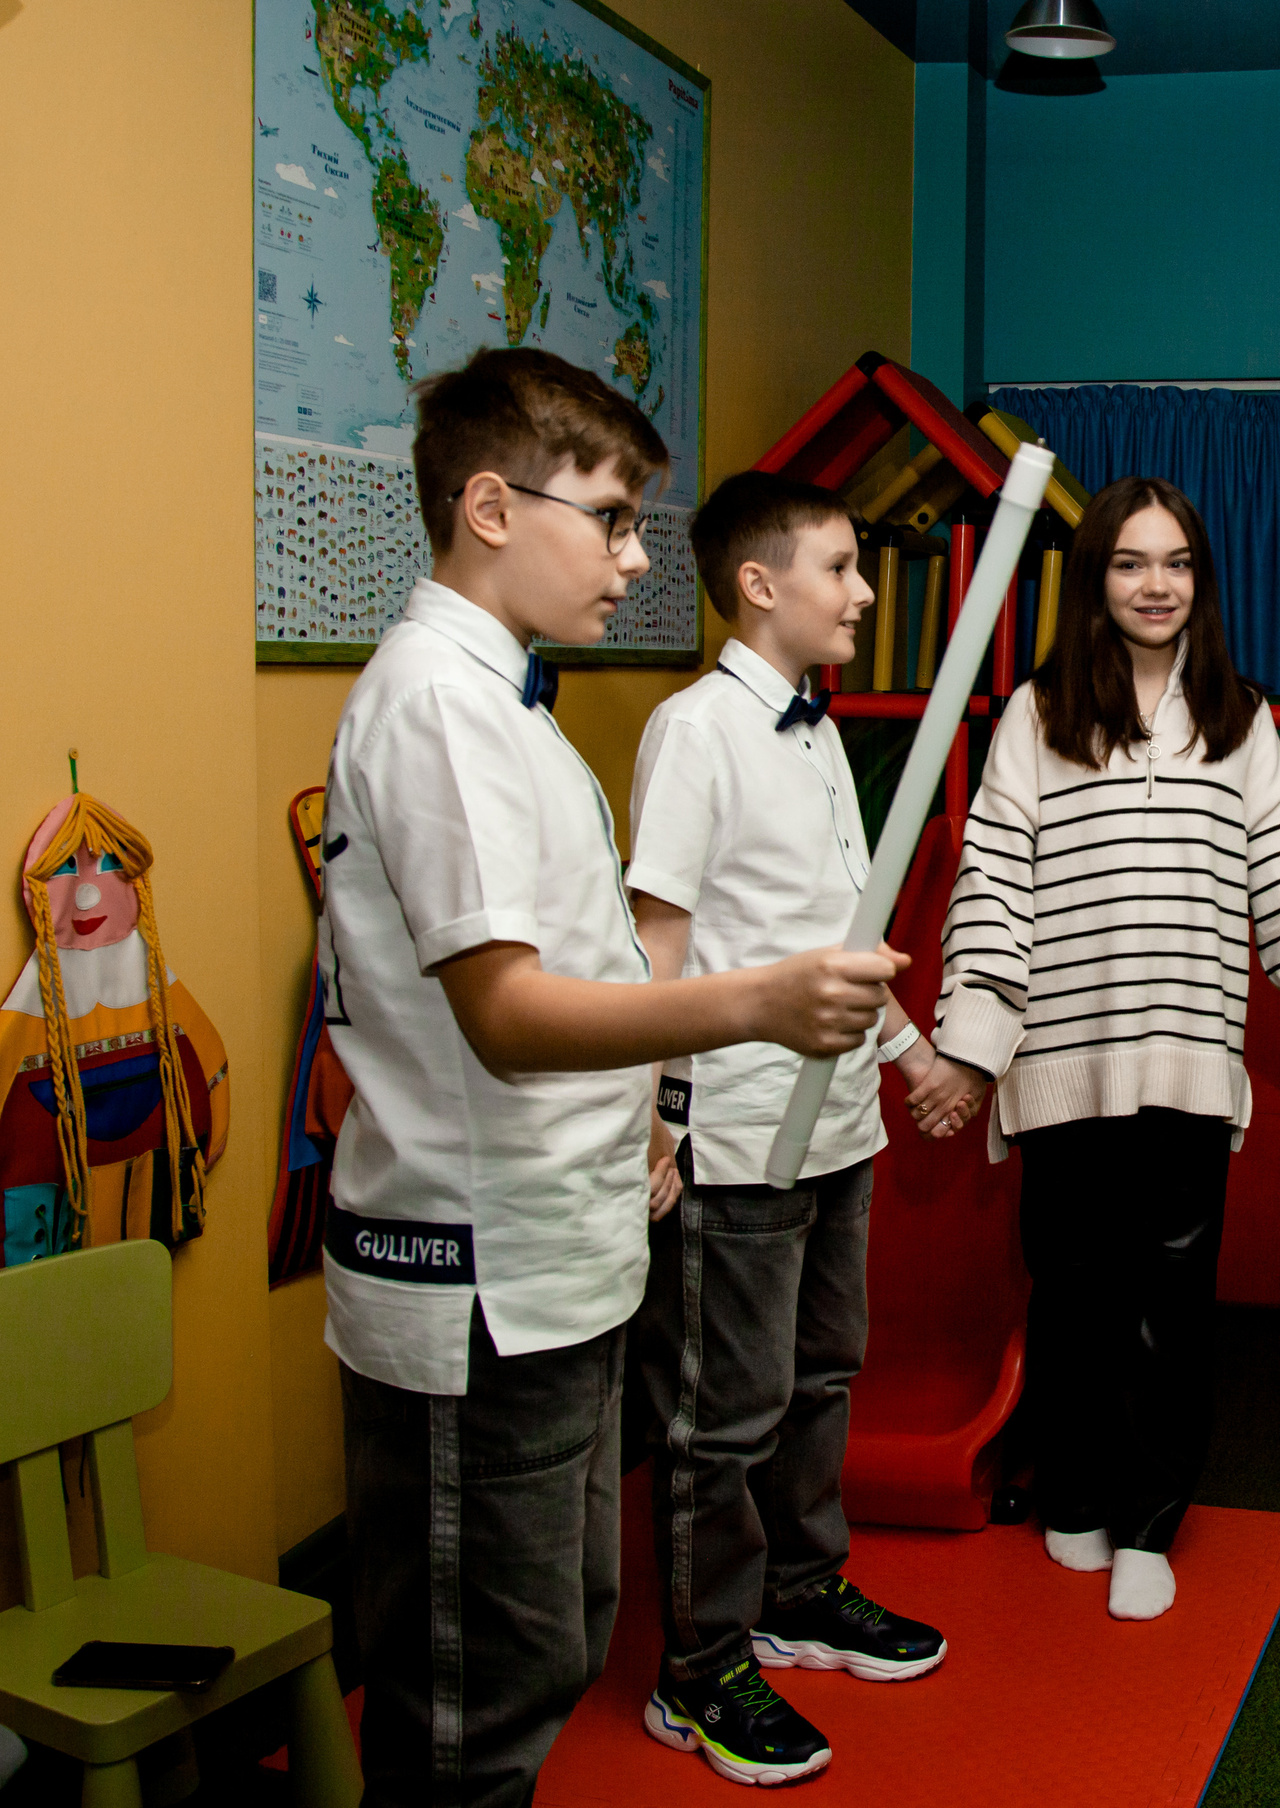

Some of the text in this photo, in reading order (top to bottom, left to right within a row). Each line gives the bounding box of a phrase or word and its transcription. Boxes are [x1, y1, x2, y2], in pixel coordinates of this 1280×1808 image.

[311, 143, 339, 165] Тихий
[324, 163, 349, 180] Океан
[657, 1086, 686, 1111] LIVER
[355, 1229, 462, 1267] GULLIVER
